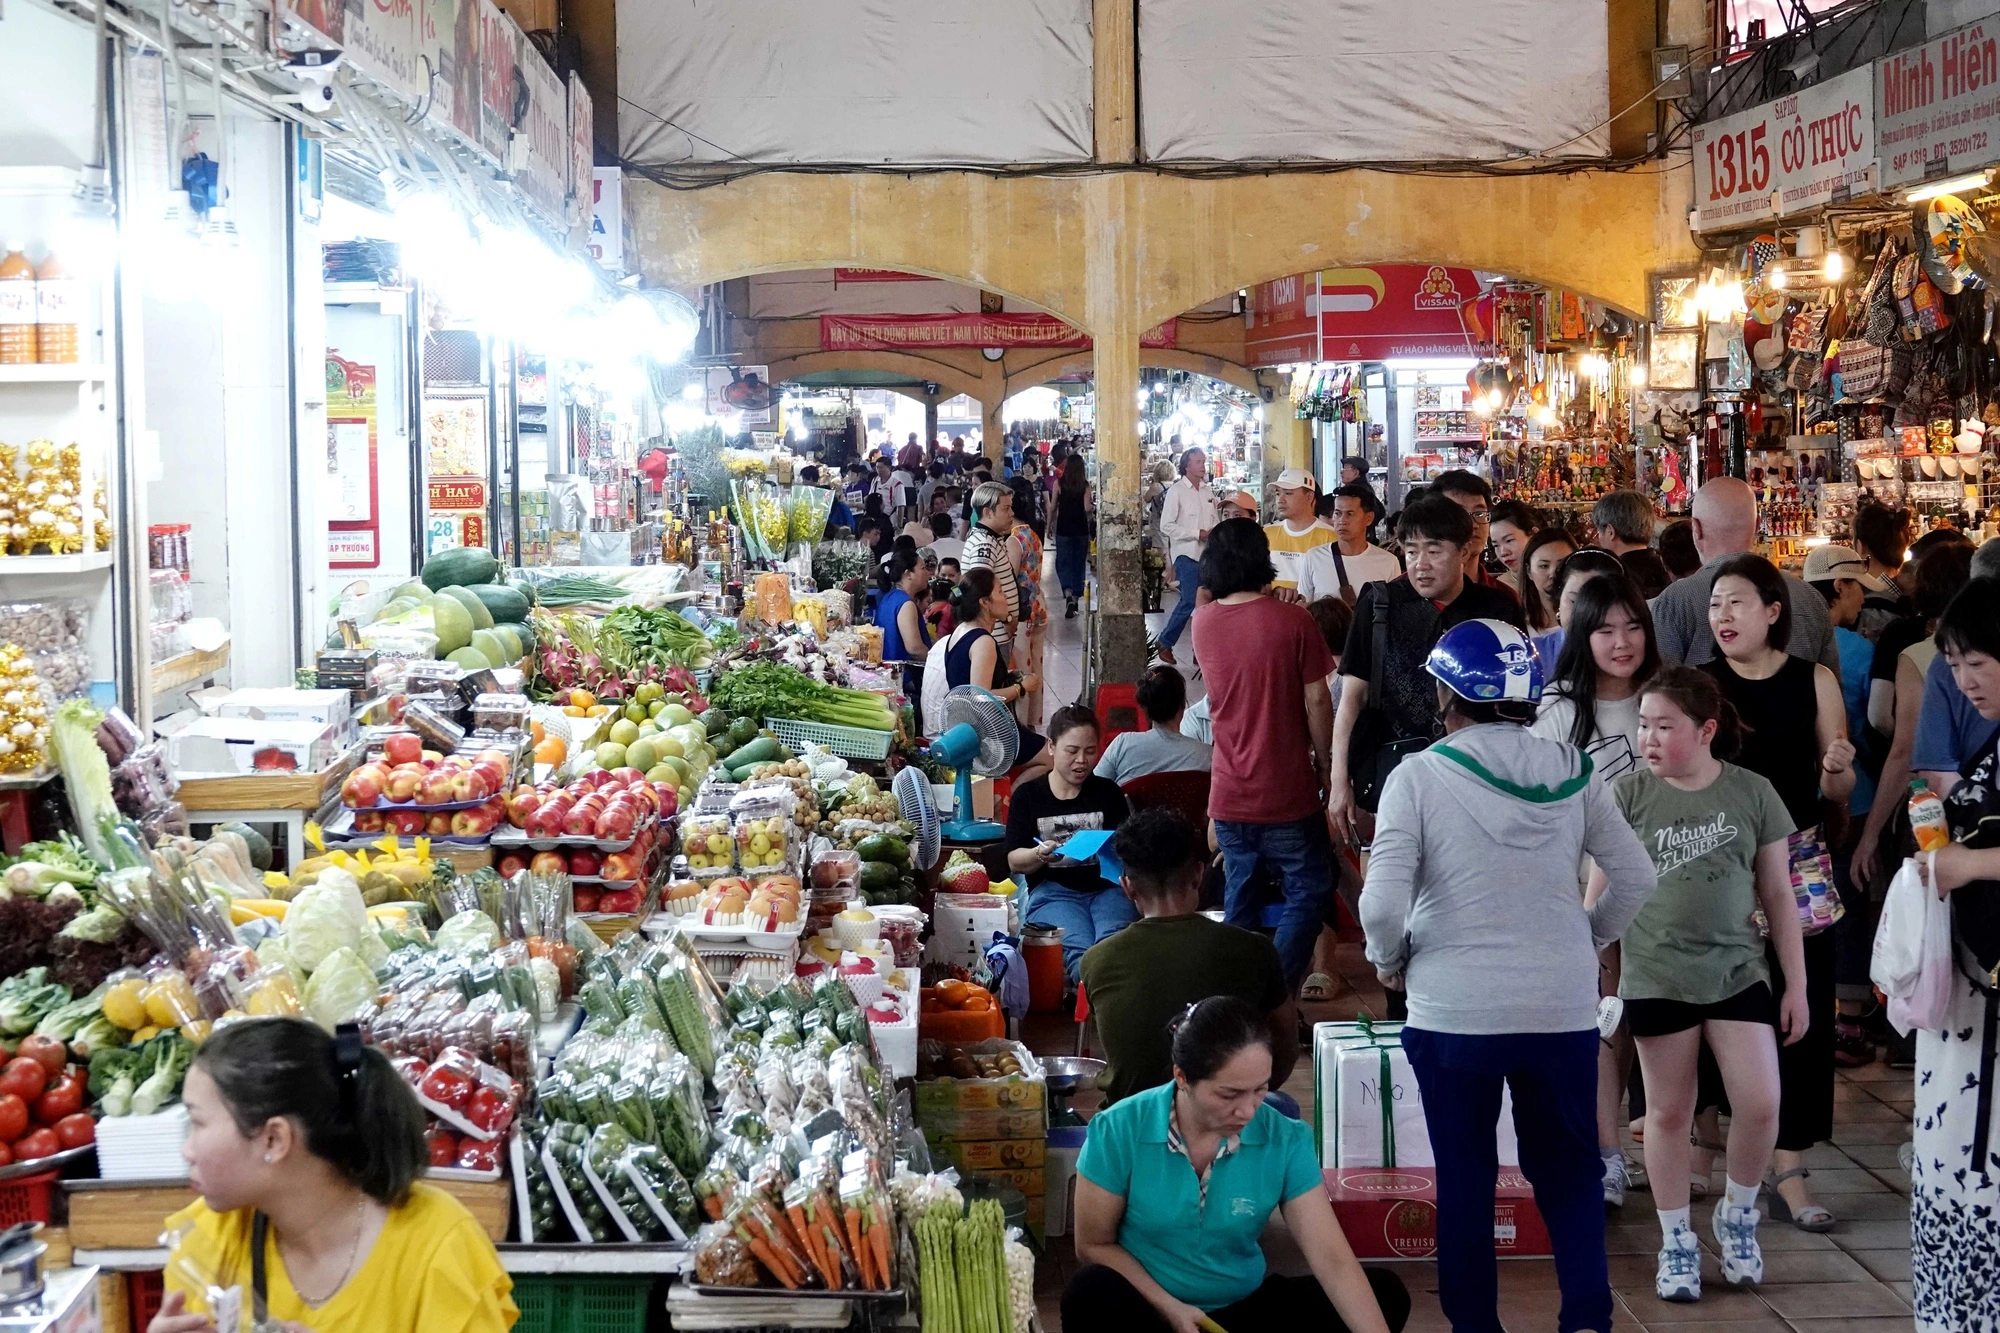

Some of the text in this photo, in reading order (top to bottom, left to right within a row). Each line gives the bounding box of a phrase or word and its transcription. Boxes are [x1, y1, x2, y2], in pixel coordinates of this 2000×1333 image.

[1884, 48, 1934, 118] Minh
[1942, 25, 1997, 101] Hiền
[1781, 114, 1805, 173] CÔ
[1808, 100, 1863, 168] THỰC
[1910, 148, 1927, 165] 1319
[1949, 131, 1987, 156] 35201722
[1707, 120, 1770, 201] 1315
[1272, 276, 1296, 306] VISSAN
[1420, 298, 1456, 307] VISSAN
[884, 324, 906, 341] DÙNG
[908, 323, 931, 341] HÀNG
[932, 323, 950, 344] VIỆT
[953, 326, 971, 341] NAM
[973, 323, 982, 340] VÌ
[983, 324, 995, 345] SỰ
[999, 322, 1018, 340] PHÁT
[1046, 322, 1057, 340] VÀ
[1391, 345, 1404, 356] TỰ
[1404, 344, 1424, 354] HÀO
[1426, 343, 1451, 353] HÀNG
[1473, 344, 1493, 352] NAM
[927, 384, 936, 394] 7
[433, 521, 453, 537] 28
[1654, 811, 1730, 851] Natural
[1662, 836, 1719, 870] FLOWERS
[1394, 1237, 1435, 1247] TREVISO
